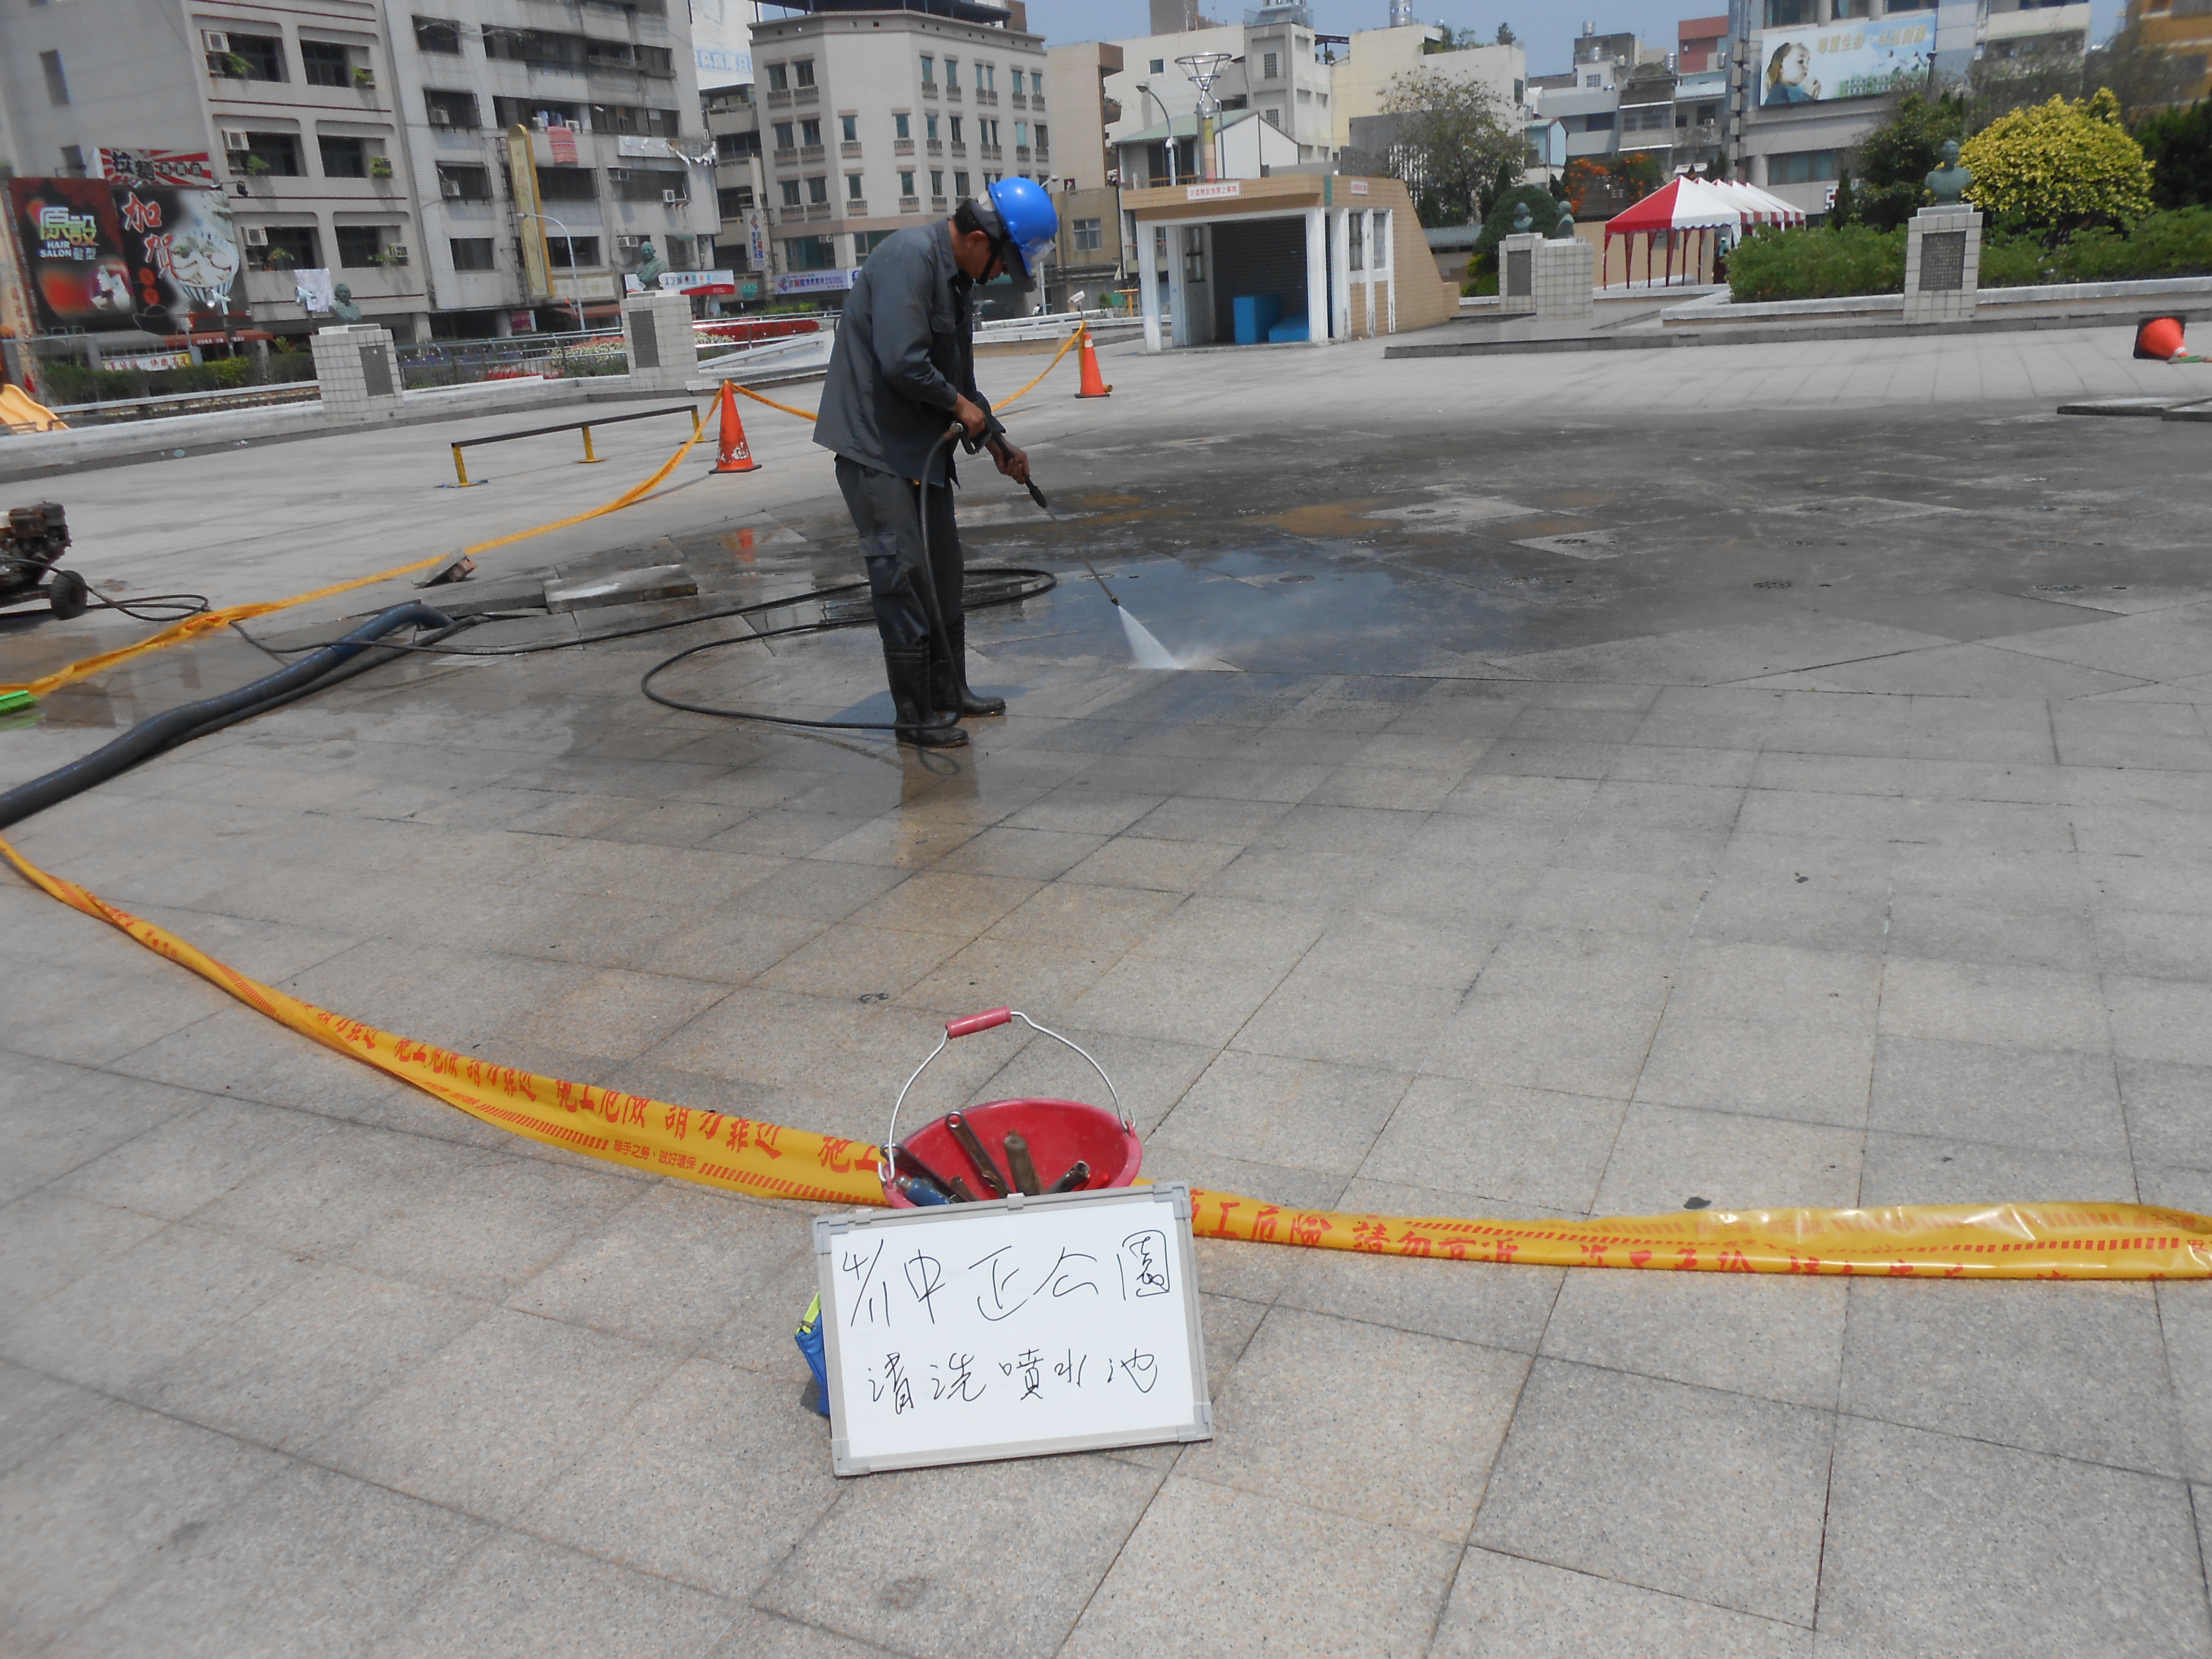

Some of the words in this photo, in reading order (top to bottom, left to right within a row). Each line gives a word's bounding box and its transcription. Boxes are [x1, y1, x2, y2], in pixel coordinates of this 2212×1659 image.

[40, 207, 100, 246] 原設
[40, 249, 72, 258] SALON
[122, 192, 179, 279] 加賀
[905, 1230, 1170, 1324] 中正公園
[869, 1349, 1157, 1415] 清洗噴水池
